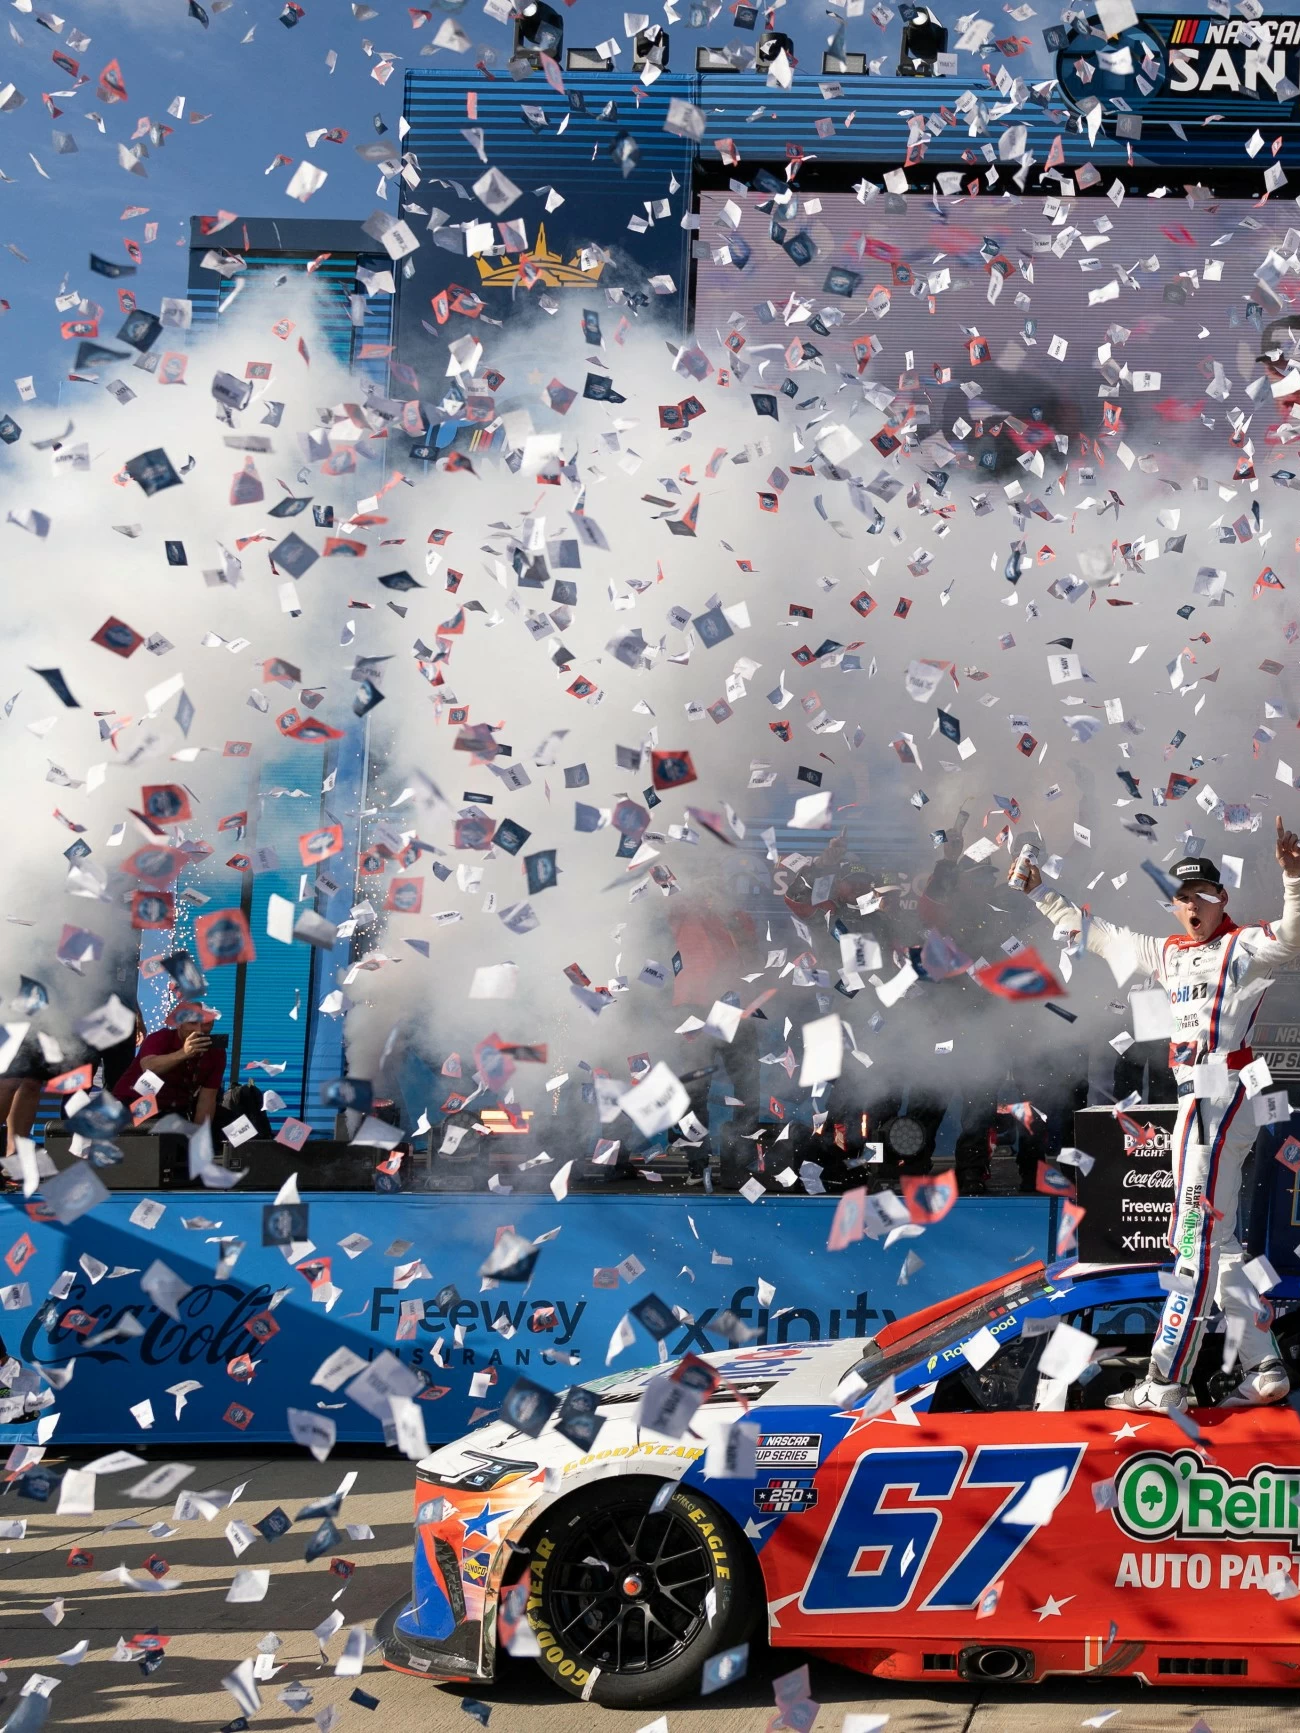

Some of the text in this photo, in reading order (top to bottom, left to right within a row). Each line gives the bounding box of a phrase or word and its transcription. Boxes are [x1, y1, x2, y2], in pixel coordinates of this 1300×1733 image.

[1169, 49, 1286, 92] SAN
[1167, 985, 1190, 1004] obil
[1123, 1170, 1174, 1188] Coca-Cola
[1185, 1186, 1194, 1206] AUTO
[1122, 1199, 1176, 1214] Freewa
[1122, 1215, 1168, 1223] INSURAN
[1122, 1232, 1171, 1252] xfinit
[371, 1286, 588, 1346] Feeway
[671, 1285, 902, 1356] xfinit
[1162, 1294, 1189, 1346] Mobi
[766, 1436, 811, 1447] NASCAR
[757, 1450, 809, 1462] UP SERIES
[769, 1488, 805, 1502] 250
[798, 1443, 1090, 1615] 67
[687, 1508, 732, 1580] EAGLE
[464, 1562, 488, 1576] SUNOCO
[1114, 1553, 1212, 1589] AUTO
[525, 1537, 593, 1687] GOODYEAR
